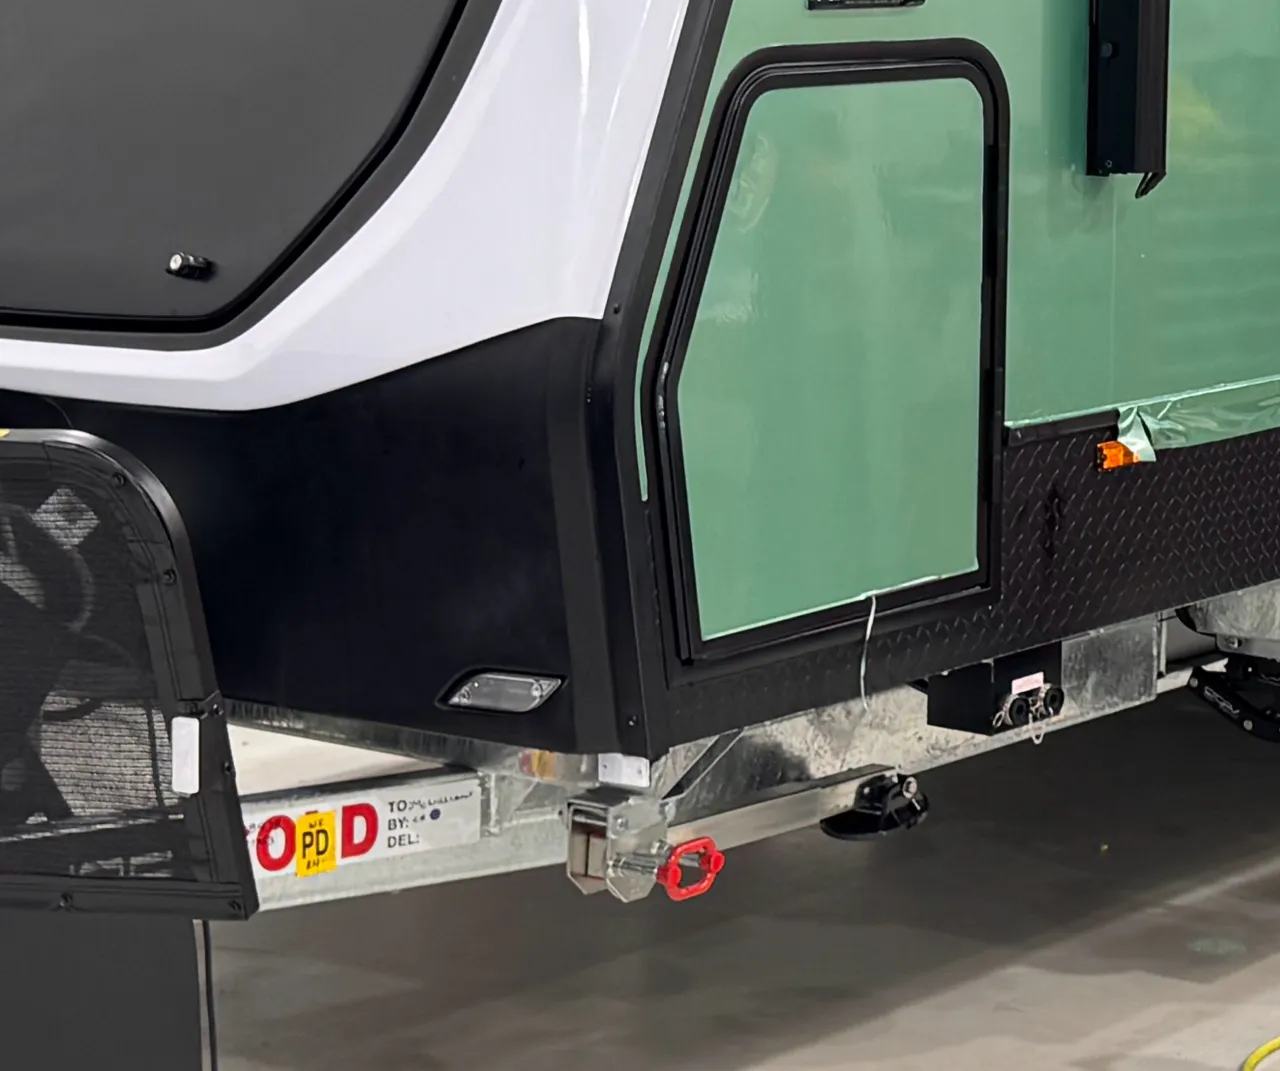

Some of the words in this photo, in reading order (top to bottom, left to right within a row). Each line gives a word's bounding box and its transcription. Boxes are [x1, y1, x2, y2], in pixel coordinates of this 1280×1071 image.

[387, 816, 409, 831] BY:
[302, 829, 329, 859] PD
[387, 833, 420, 849] DEL:
